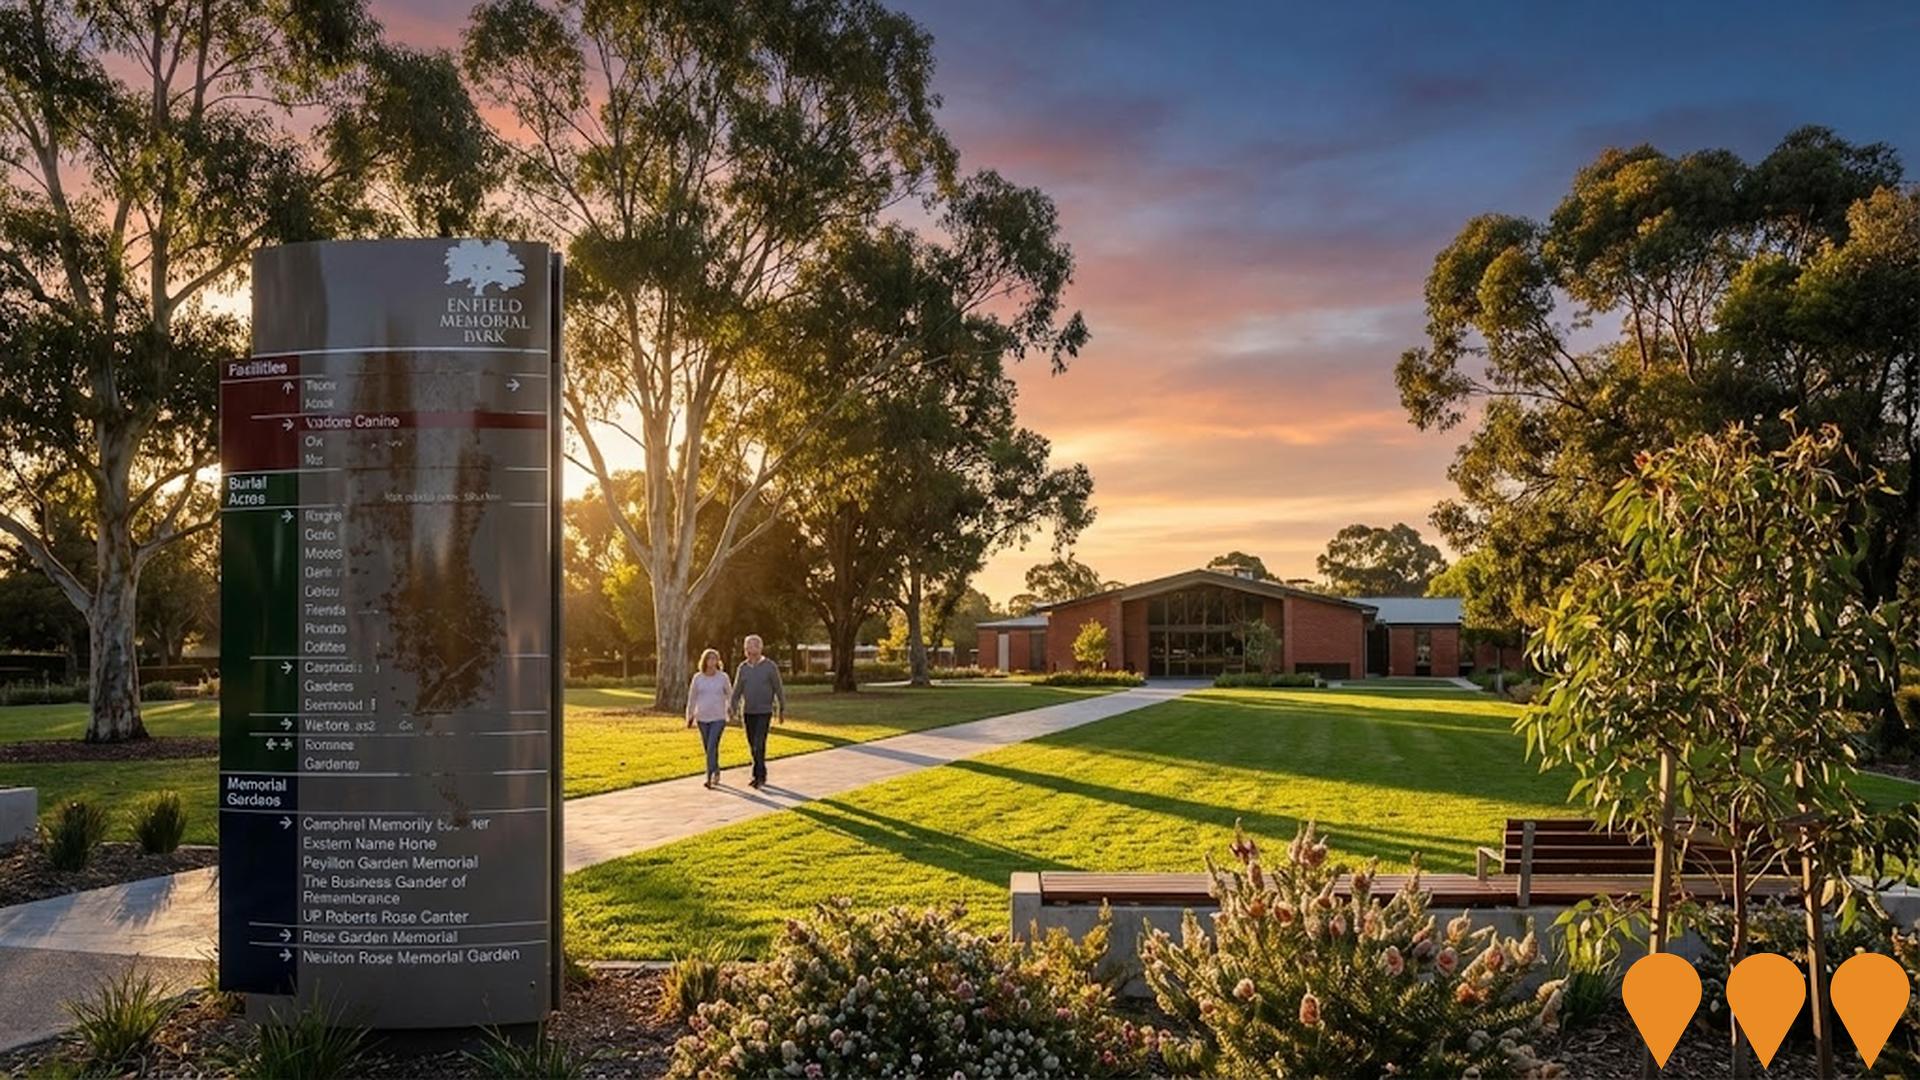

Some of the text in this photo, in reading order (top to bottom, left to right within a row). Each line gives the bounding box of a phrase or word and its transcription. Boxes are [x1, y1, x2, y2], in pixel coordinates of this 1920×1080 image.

[447, 298, 523, 313] ENFIELD
[227, 777, 287, 791] Memorial
[356, 837, 395, 850] Name
[358, 856, 408, 869] Garden
[413, 855, 479, 869] Memorial
[331, 875, 392, 888] Business
[452, 874, 468, 888] of
[382, 910, 417, 924] Rose
[339, 930, 388, 943] Garden
[393, 929, 458, 943] Memorial
[359, 951, 393, 965] Rose
[397, 950, 463, 964] Memorial
[467, 948, 520, 963] Garden
